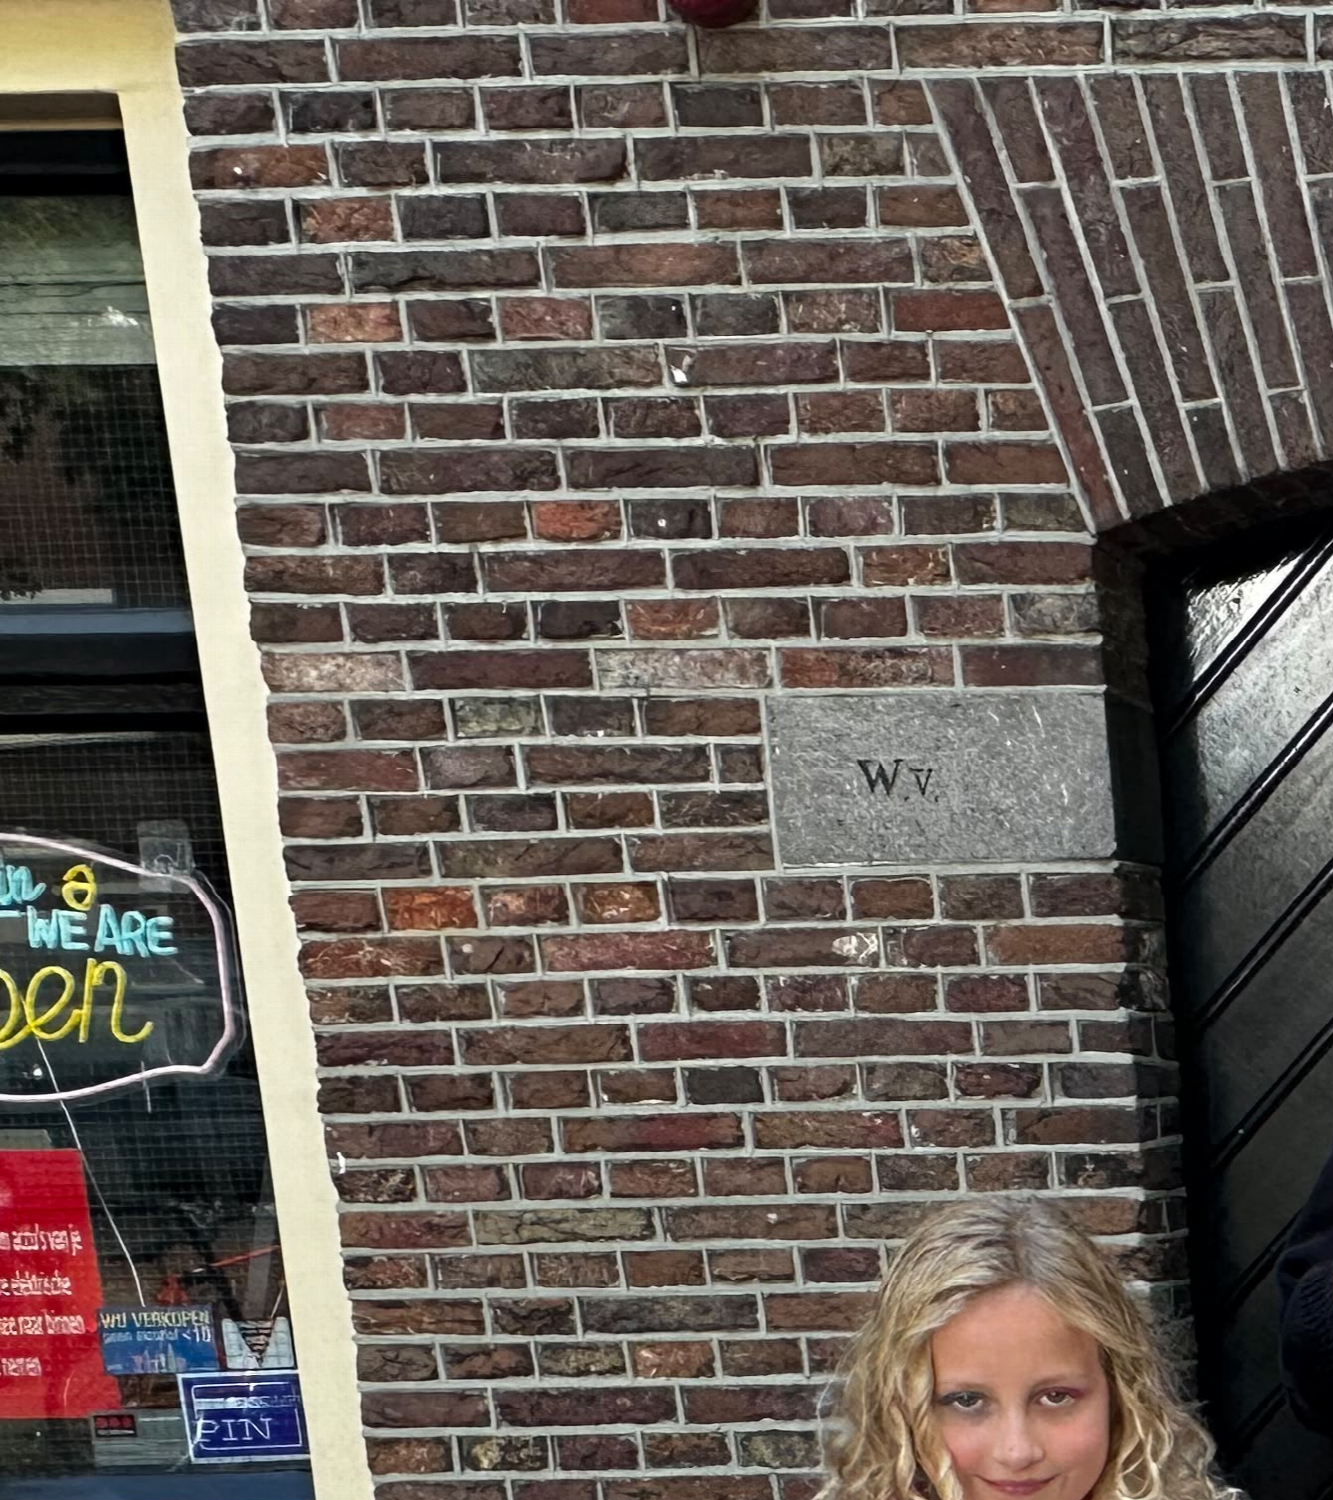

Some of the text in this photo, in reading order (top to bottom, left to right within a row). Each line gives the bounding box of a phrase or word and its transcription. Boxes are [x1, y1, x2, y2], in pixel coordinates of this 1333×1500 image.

[27, 903, 179, 958] WE ARE
[193, 1416, 273, 1443] PIN
